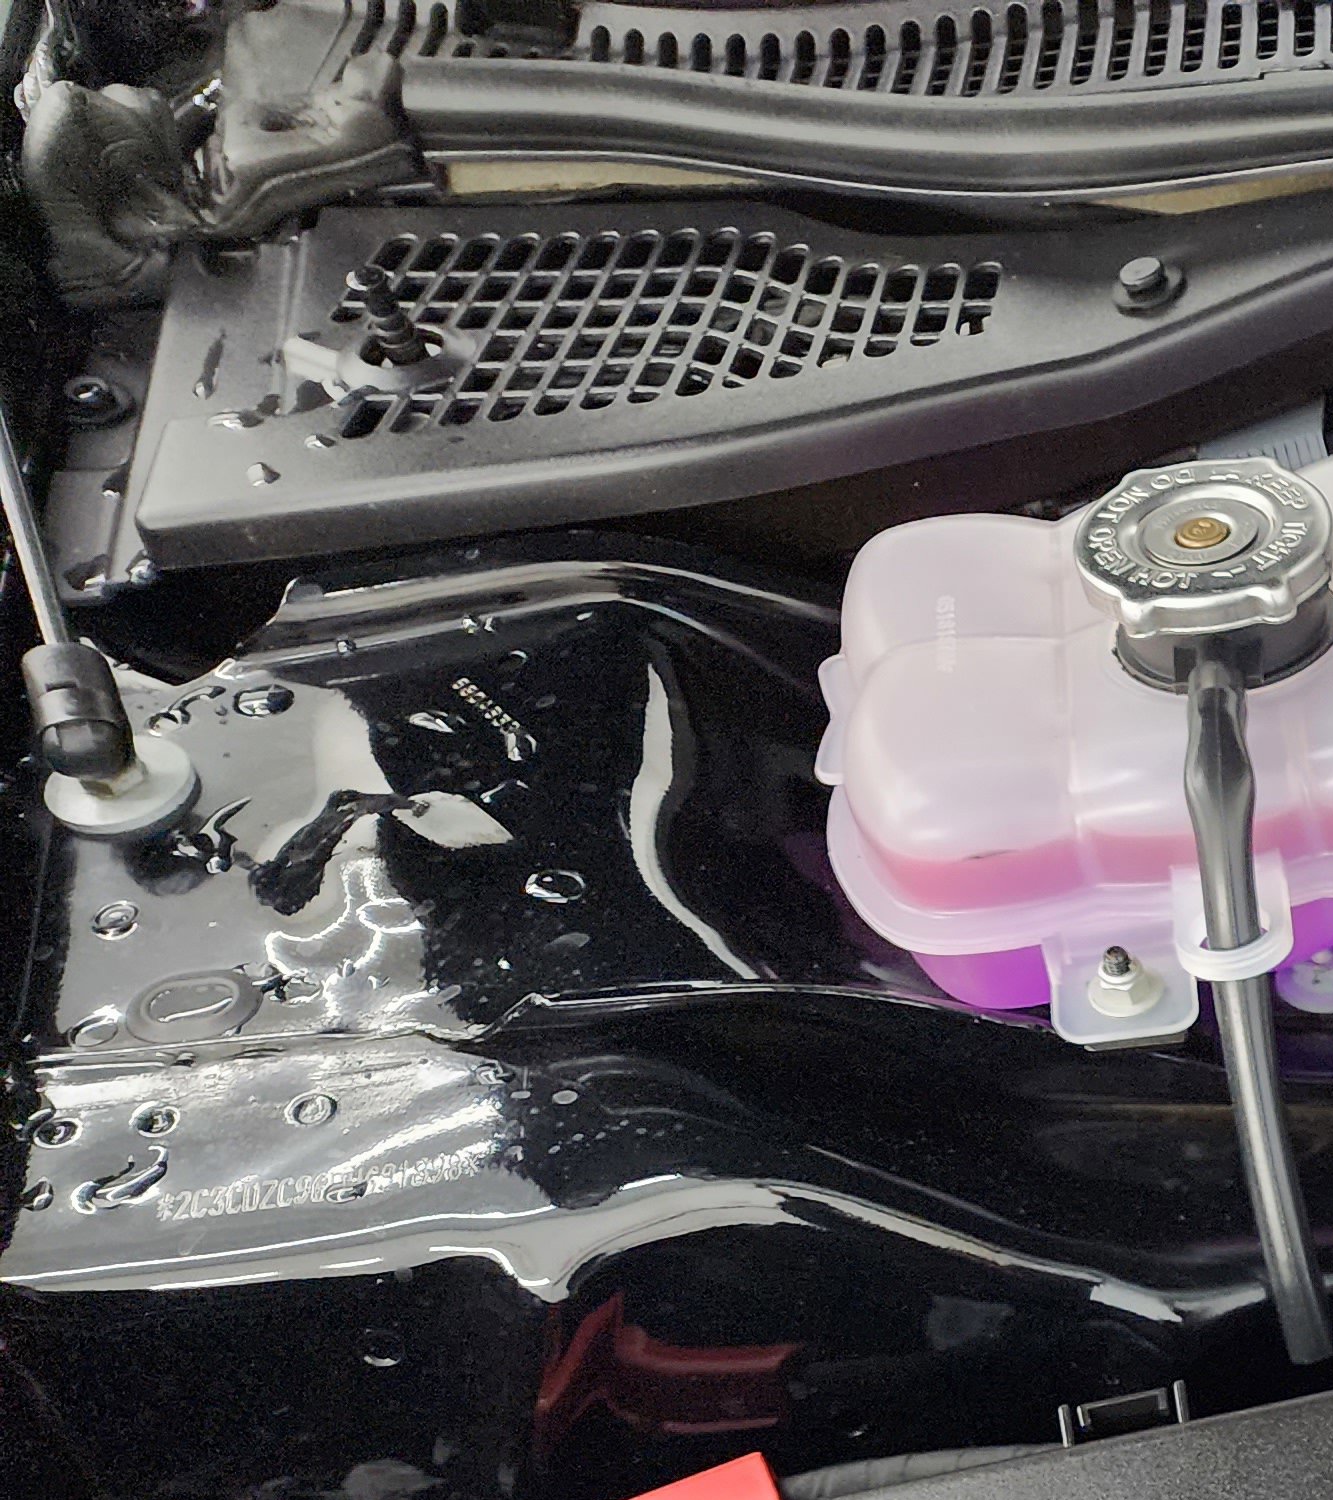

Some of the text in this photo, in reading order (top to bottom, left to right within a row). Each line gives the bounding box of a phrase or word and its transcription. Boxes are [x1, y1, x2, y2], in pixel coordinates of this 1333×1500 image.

[1150, 468, 1196, 490] DO
[1096, 485, 1149, 524] NOT
[1248, 473, 1309, 572] KEEP TIGHT
[1087, 527, 1137, 577] OPEN
[1127, 565, 1198, 590] HOT
